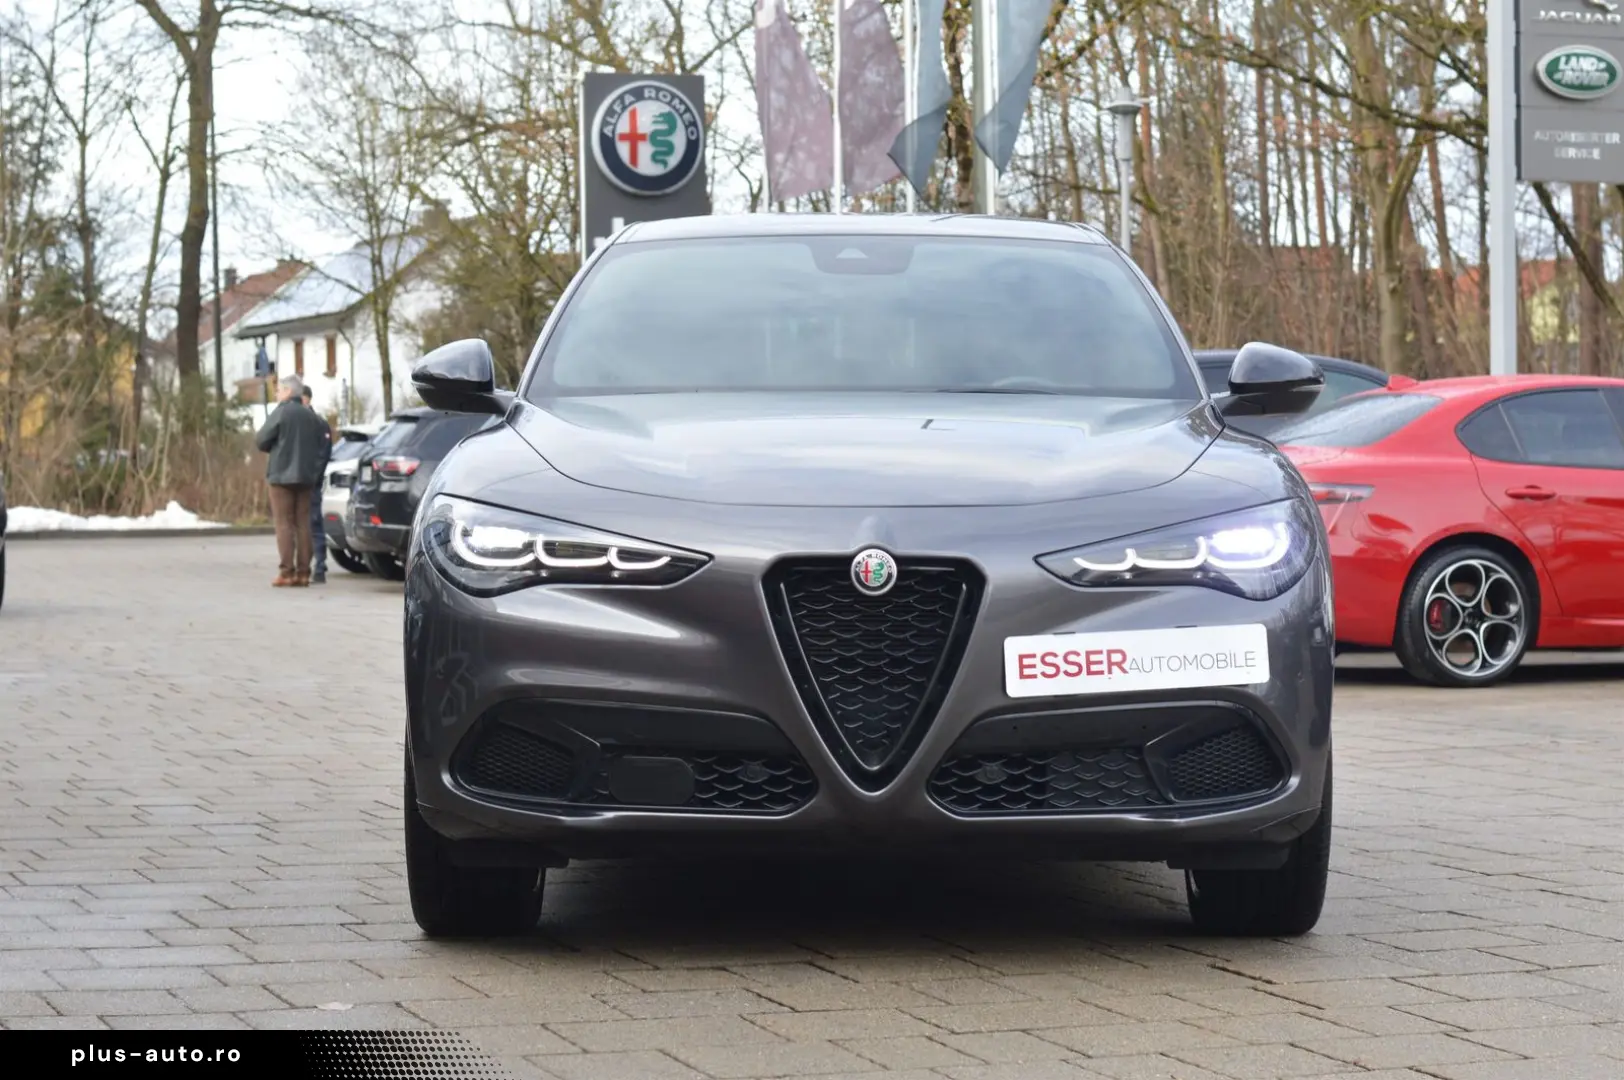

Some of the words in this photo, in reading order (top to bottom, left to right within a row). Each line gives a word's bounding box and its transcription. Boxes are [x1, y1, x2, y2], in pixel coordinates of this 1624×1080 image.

[1533, 10, 1621, 24] JAGUAR
[1558, 55, 1600, 70] LAND
[603, 94, 636, 138] ALFA
[643, 87, 698, 140] ROMEO
